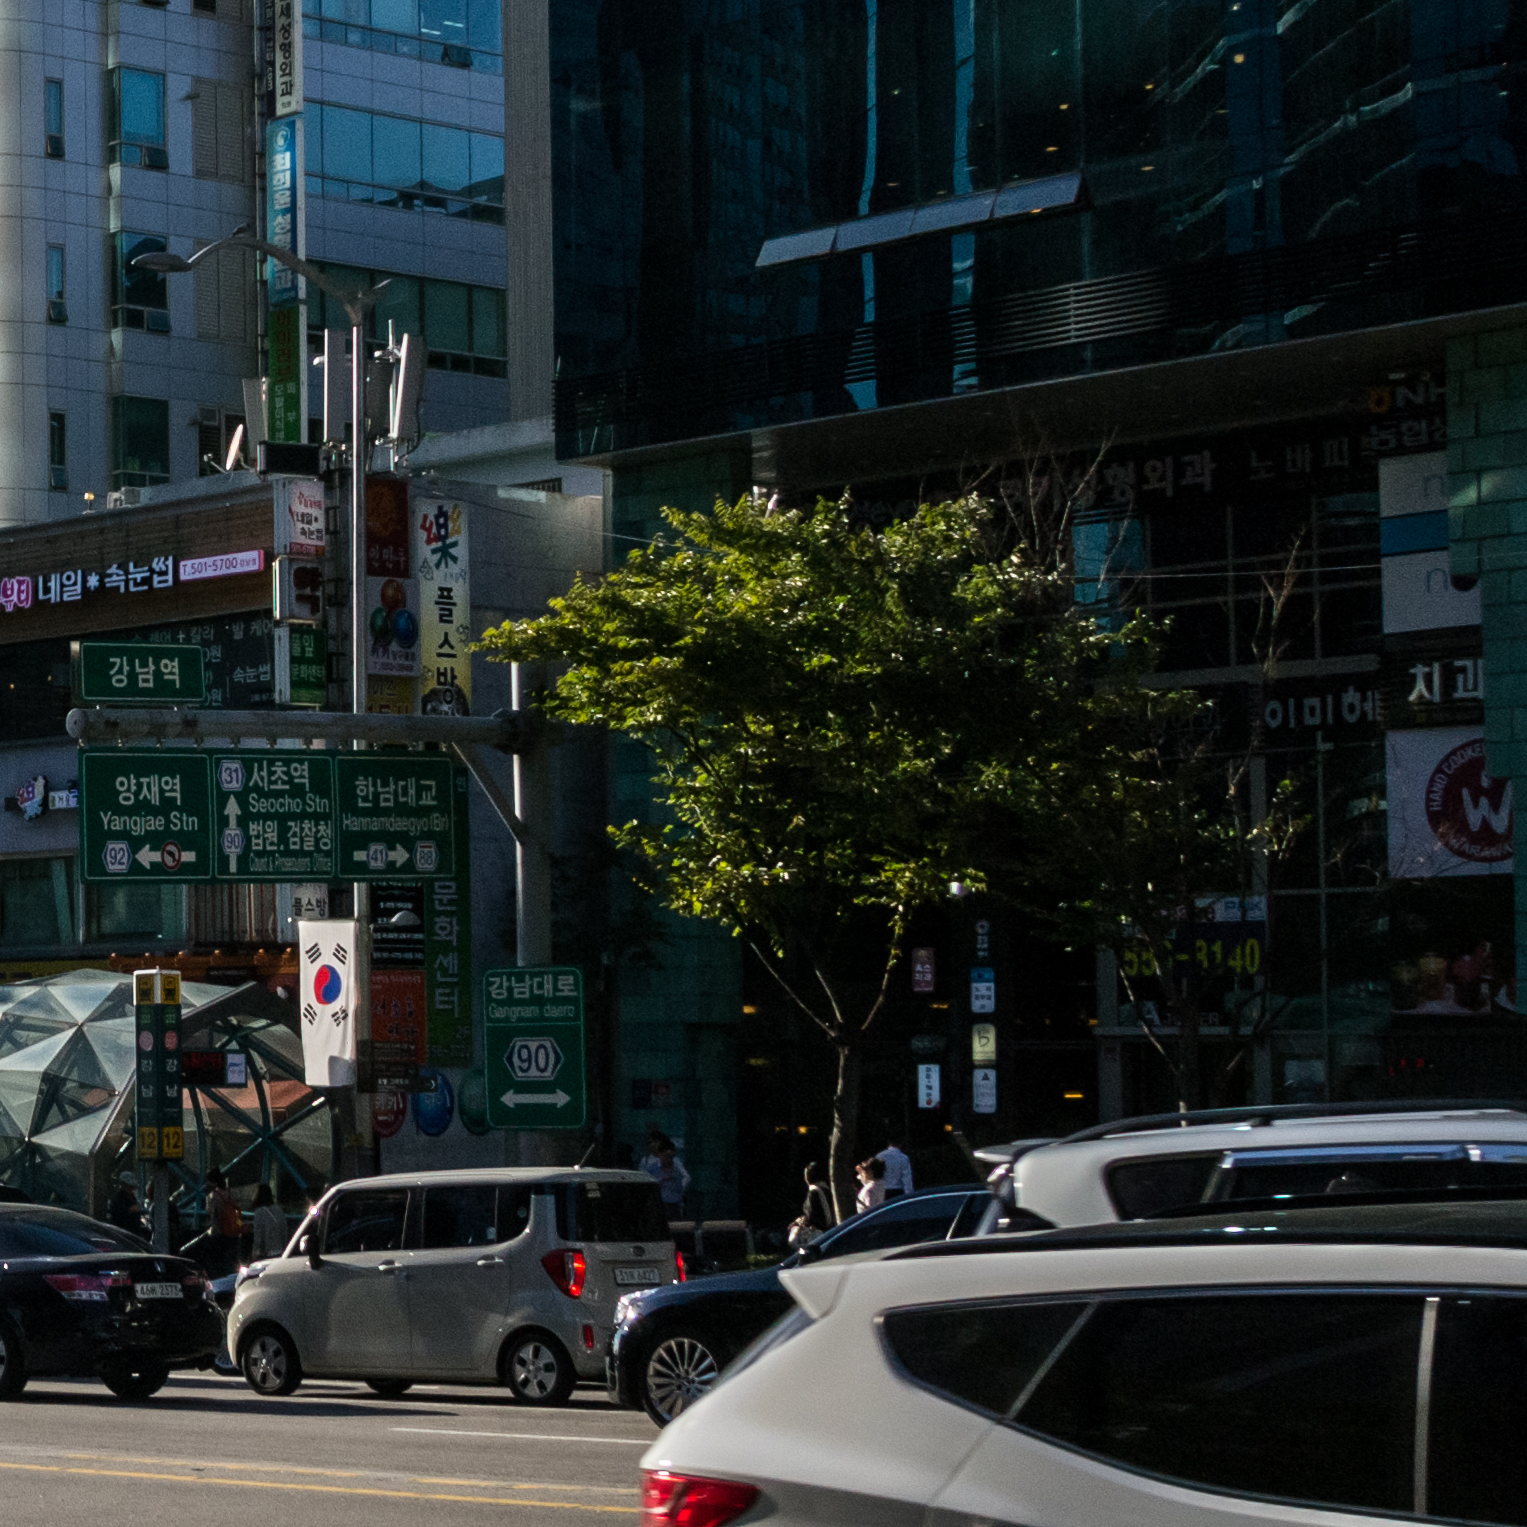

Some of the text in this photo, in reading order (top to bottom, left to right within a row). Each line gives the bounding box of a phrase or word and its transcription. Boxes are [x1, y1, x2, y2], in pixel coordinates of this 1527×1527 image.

[38, 570, 83, 604] 네일
[103, 555, 174, 594] 속눈썹
[434, 587, 458, 707] 플스방
[108, 656, 181, 690] 강남역
[221, 765, 242, 786] 31
[248, 760, 311, 792] 서초역
[1428, 743, 1485, 812] HAND COOKE
[114, 773, 182, 807] 양재역
[354, 776, 439, 808] 한남대교
[248, 794, 331, 814] Seocho Stn
[99, 811, 200, 834] Yangjae Stn
[224, 832, 243, 851] 90
[106, 846, 128, 867] 92
[368, 847, 388, 866] 41
[292, 897, 327, 918] 플스방
[431, 880, 460, 1018] 문화센터
[488, 974, 580, 1000] 강남대로
[488, 1004, 539, 1022] Gangnam
[517, 1043, 555, 1074] 90
[165, 1129, 181, 1150] 12
